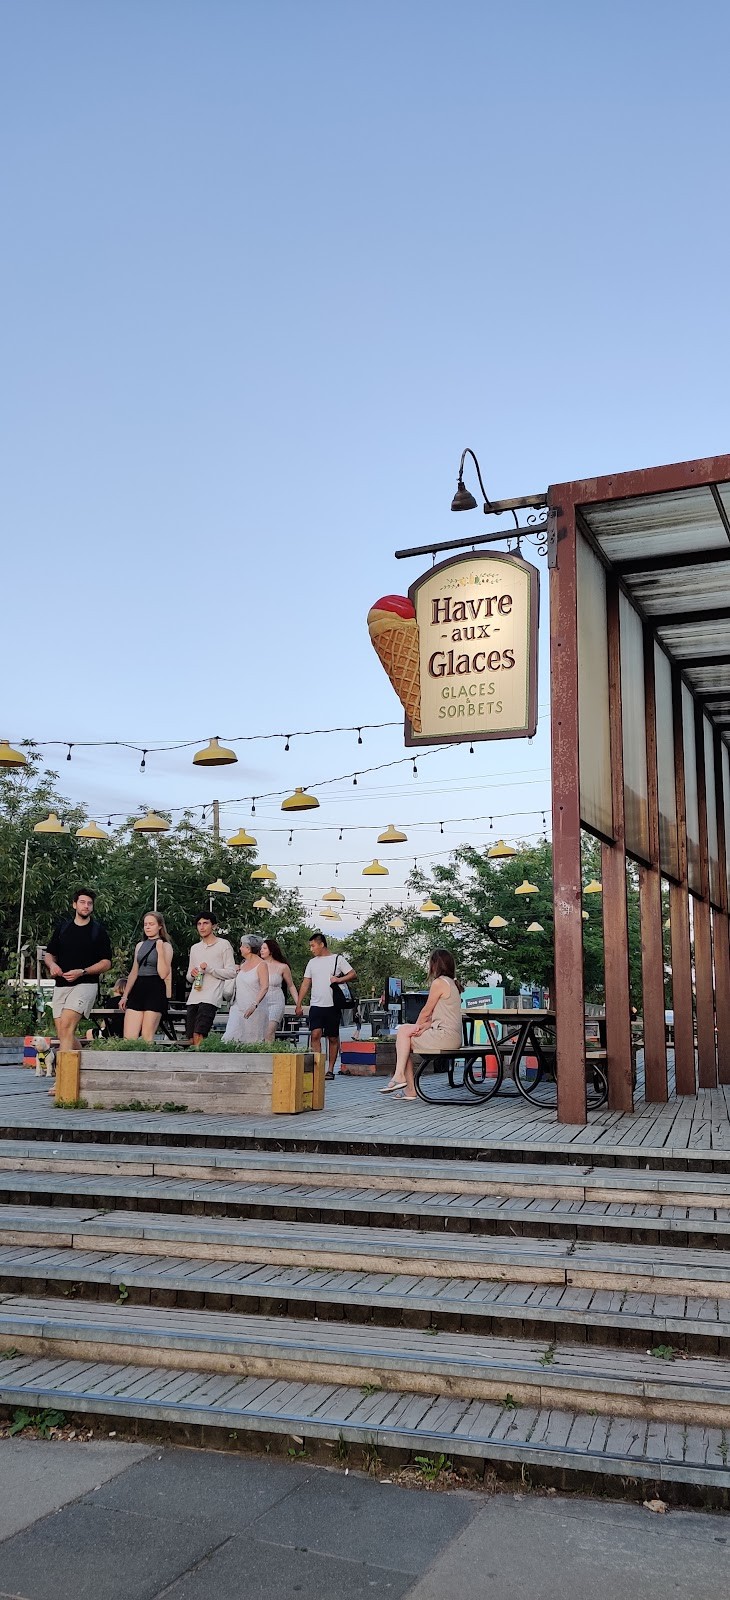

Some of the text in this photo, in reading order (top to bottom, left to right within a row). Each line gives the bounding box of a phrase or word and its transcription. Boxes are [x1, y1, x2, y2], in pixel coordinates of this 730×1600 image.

[430, 595, 513, 626] Havre
[428, 649, 515, 677] Glaces
[441, 682, 496, 699] GLACES
[438, 701, 503, 719] SORBETS
